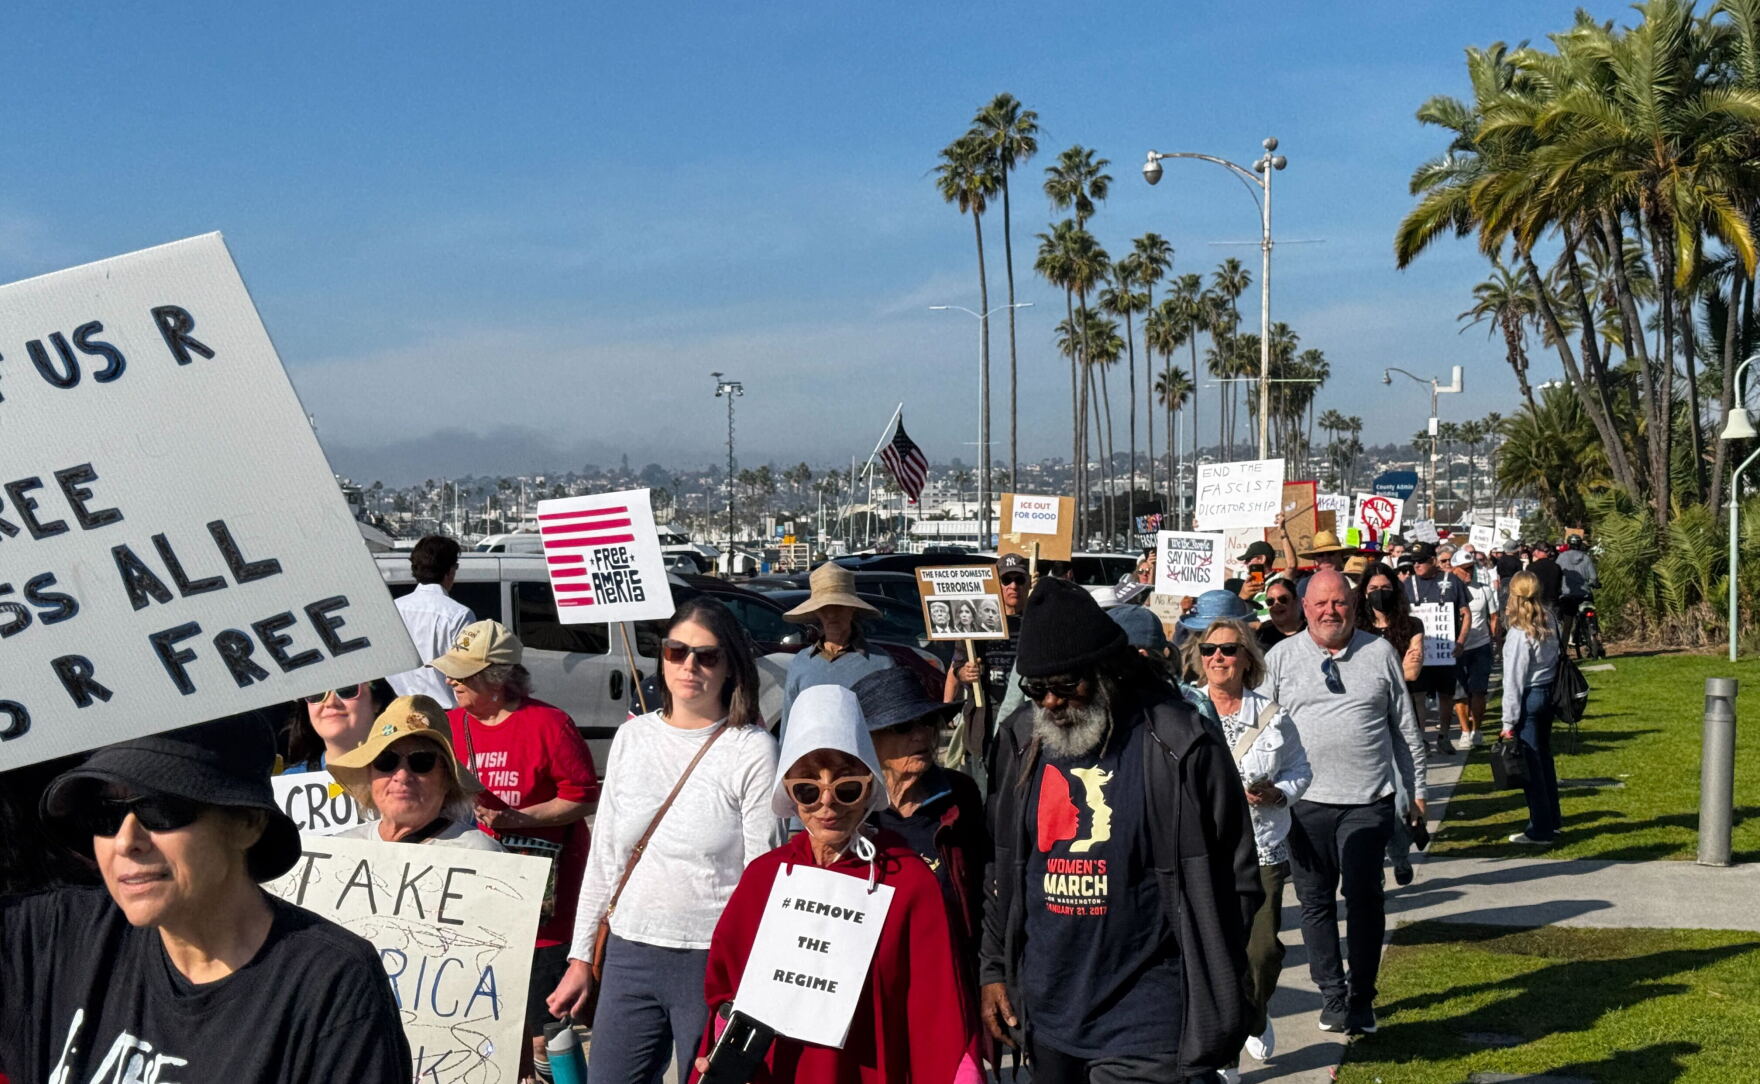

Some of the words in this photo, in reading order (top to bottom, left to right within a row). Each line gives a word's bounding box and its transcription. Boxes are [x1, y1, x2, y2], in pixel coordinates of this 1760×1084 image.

[26, 320, 126, 389] US
[151, 305, 215, 366] R
[1203, 467, 1230, 478] END
[1240, 463, 1263, 473] THE
[1201, 480, 1275, 501] FASCIST
[1020, 501, 1033, 509] ICE
[1034, 502, 1051, 510] OUT
[1198, 501, 1276, 516] DICTATORSHIP
[1359, 498, 1398, 514] POLICE
[1014, 511, 1030, 519] FOR
[1032, 512, 1057, 520] GOOD
[111, 520, 283, 611] ALL
[1167, 551, 1183, 565] SAY
[1183, 552, 1197, 566] NO
[922, 571, 934, 579] THE
[934, 570, 949, 578] FACE
[950, 570, 958, 578] OF
[960, 569, 991, 578] DOMESTIC
[1180, 566, 1211, 584] KINGS
[936, 582, 981, 593] TERRORISM
[1167, 595, 1180, 609] King
[51, 654, 113, 708] R
[149, 595, 371, 695] FREE
[488, 770, 519, 787] THIS
[286, 783, 365, 830] CRO
[1047, 858, 1107, 874] WOMEN'S
[296, 850, 477, 926] TAKE
[1043, 873, 1108, 896] MARCH
[794, 898, 865, 924] REMOVE
[1089, 906, 1107, 915] 2017
[798, 936, 831, 953] THE
[772, 969, 838, 994] REGIME
